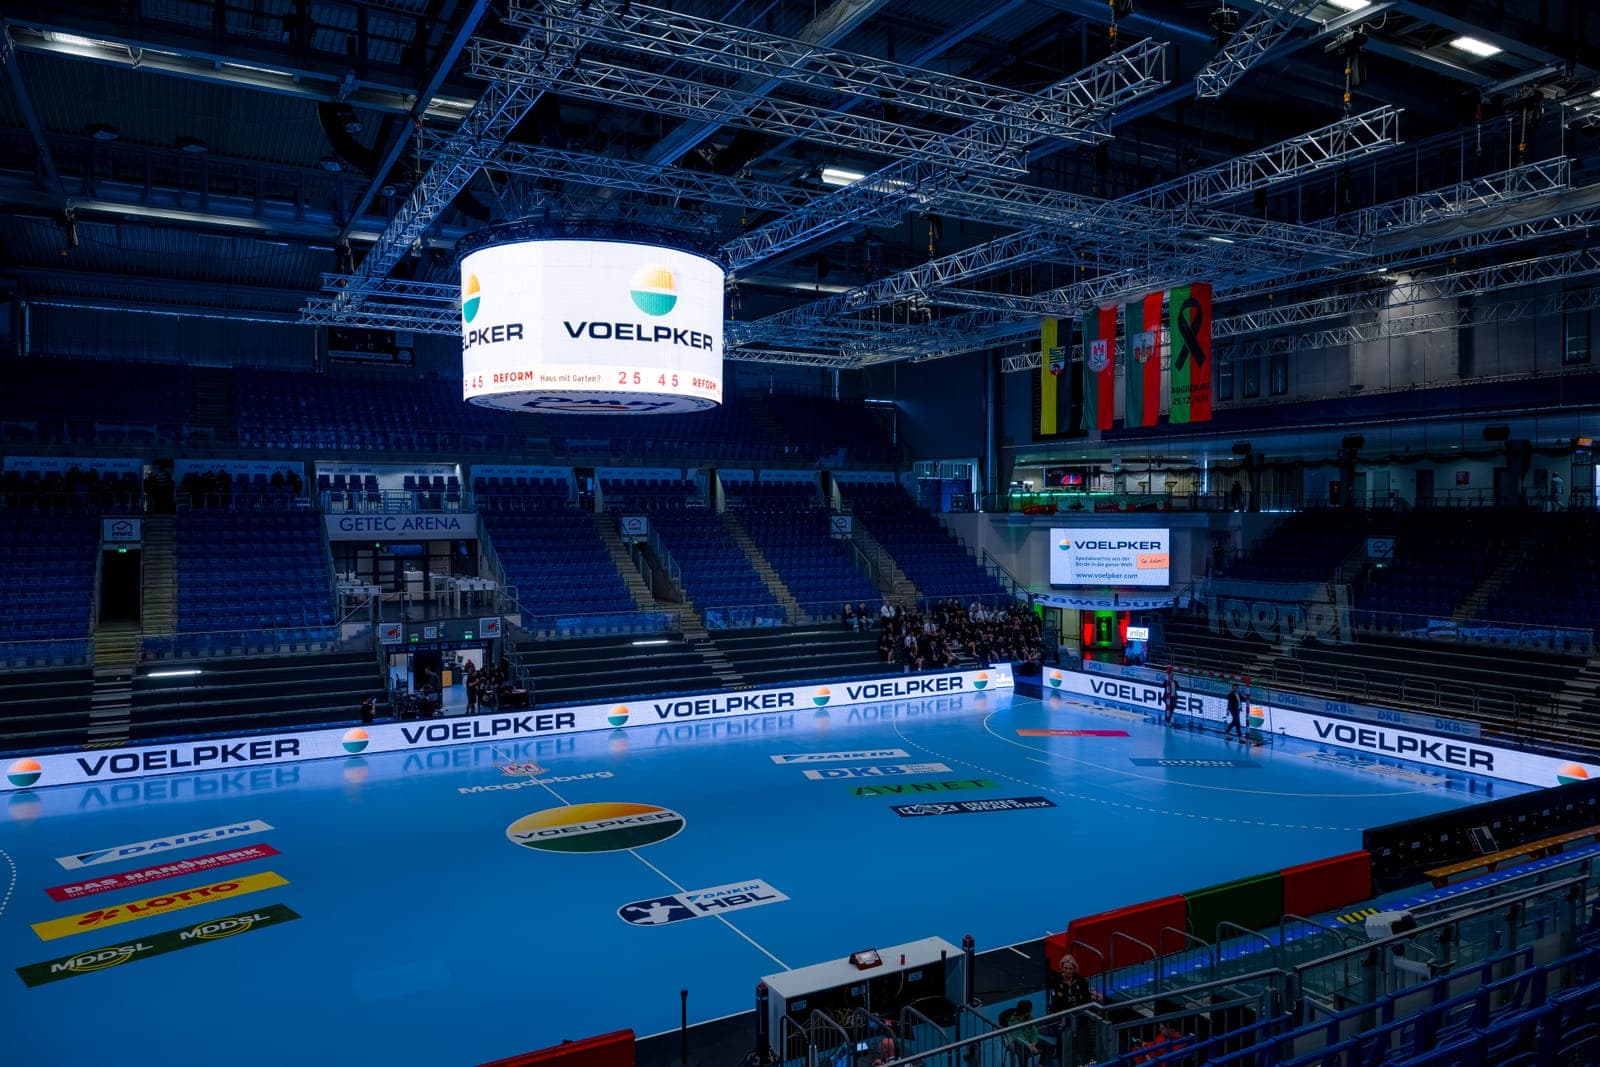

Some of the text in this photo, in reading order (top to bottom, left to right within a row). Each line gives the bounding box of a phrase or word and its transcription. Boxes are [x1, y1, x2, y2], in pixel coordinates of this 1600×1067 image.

[563, 321, 713, 352] VOELPKER
[493, 370, 534, 384] REFORM
[558, 374, 570, 382] mit
[339, 516, 461, 532] GETEC ARENA
[1074, 541, 1161, 550] VOELPKER
[847, 676, 963, 700] VOELPKER
[653, 692, 794, 719] VOELPKER
[1278, 693, 1297, 705] DKB
[1325, 702, 1346, 713] DKB
[1377, 710, 1401, 722] DKB
[1435, 719, 1460, 732] DKB
[401, 712, 576, 744] VOELPKER
[77, 738, 300, 777] VOELPKER
[807, 751, 894, 760] DAIKIN
[1312, 720, 1494, 771] VOELPKER
[456, 771, 614, 795] Magdeburg
[817, 766, 906, 778] DKB
[514, 811, 677, 840] VOELPKER
[118, 825, 251, 856] DAIKIN
[64, 847, 263, 895] DAS HANDWERK
[126, 882, 239, 913] LOTTO
[695, 892, 777, 912] HBL
[703, 885, 761, 900] DAIKIN
[180, 913, 271, 941] MDDSL
[50, 942, 154, 973] MDDSL
